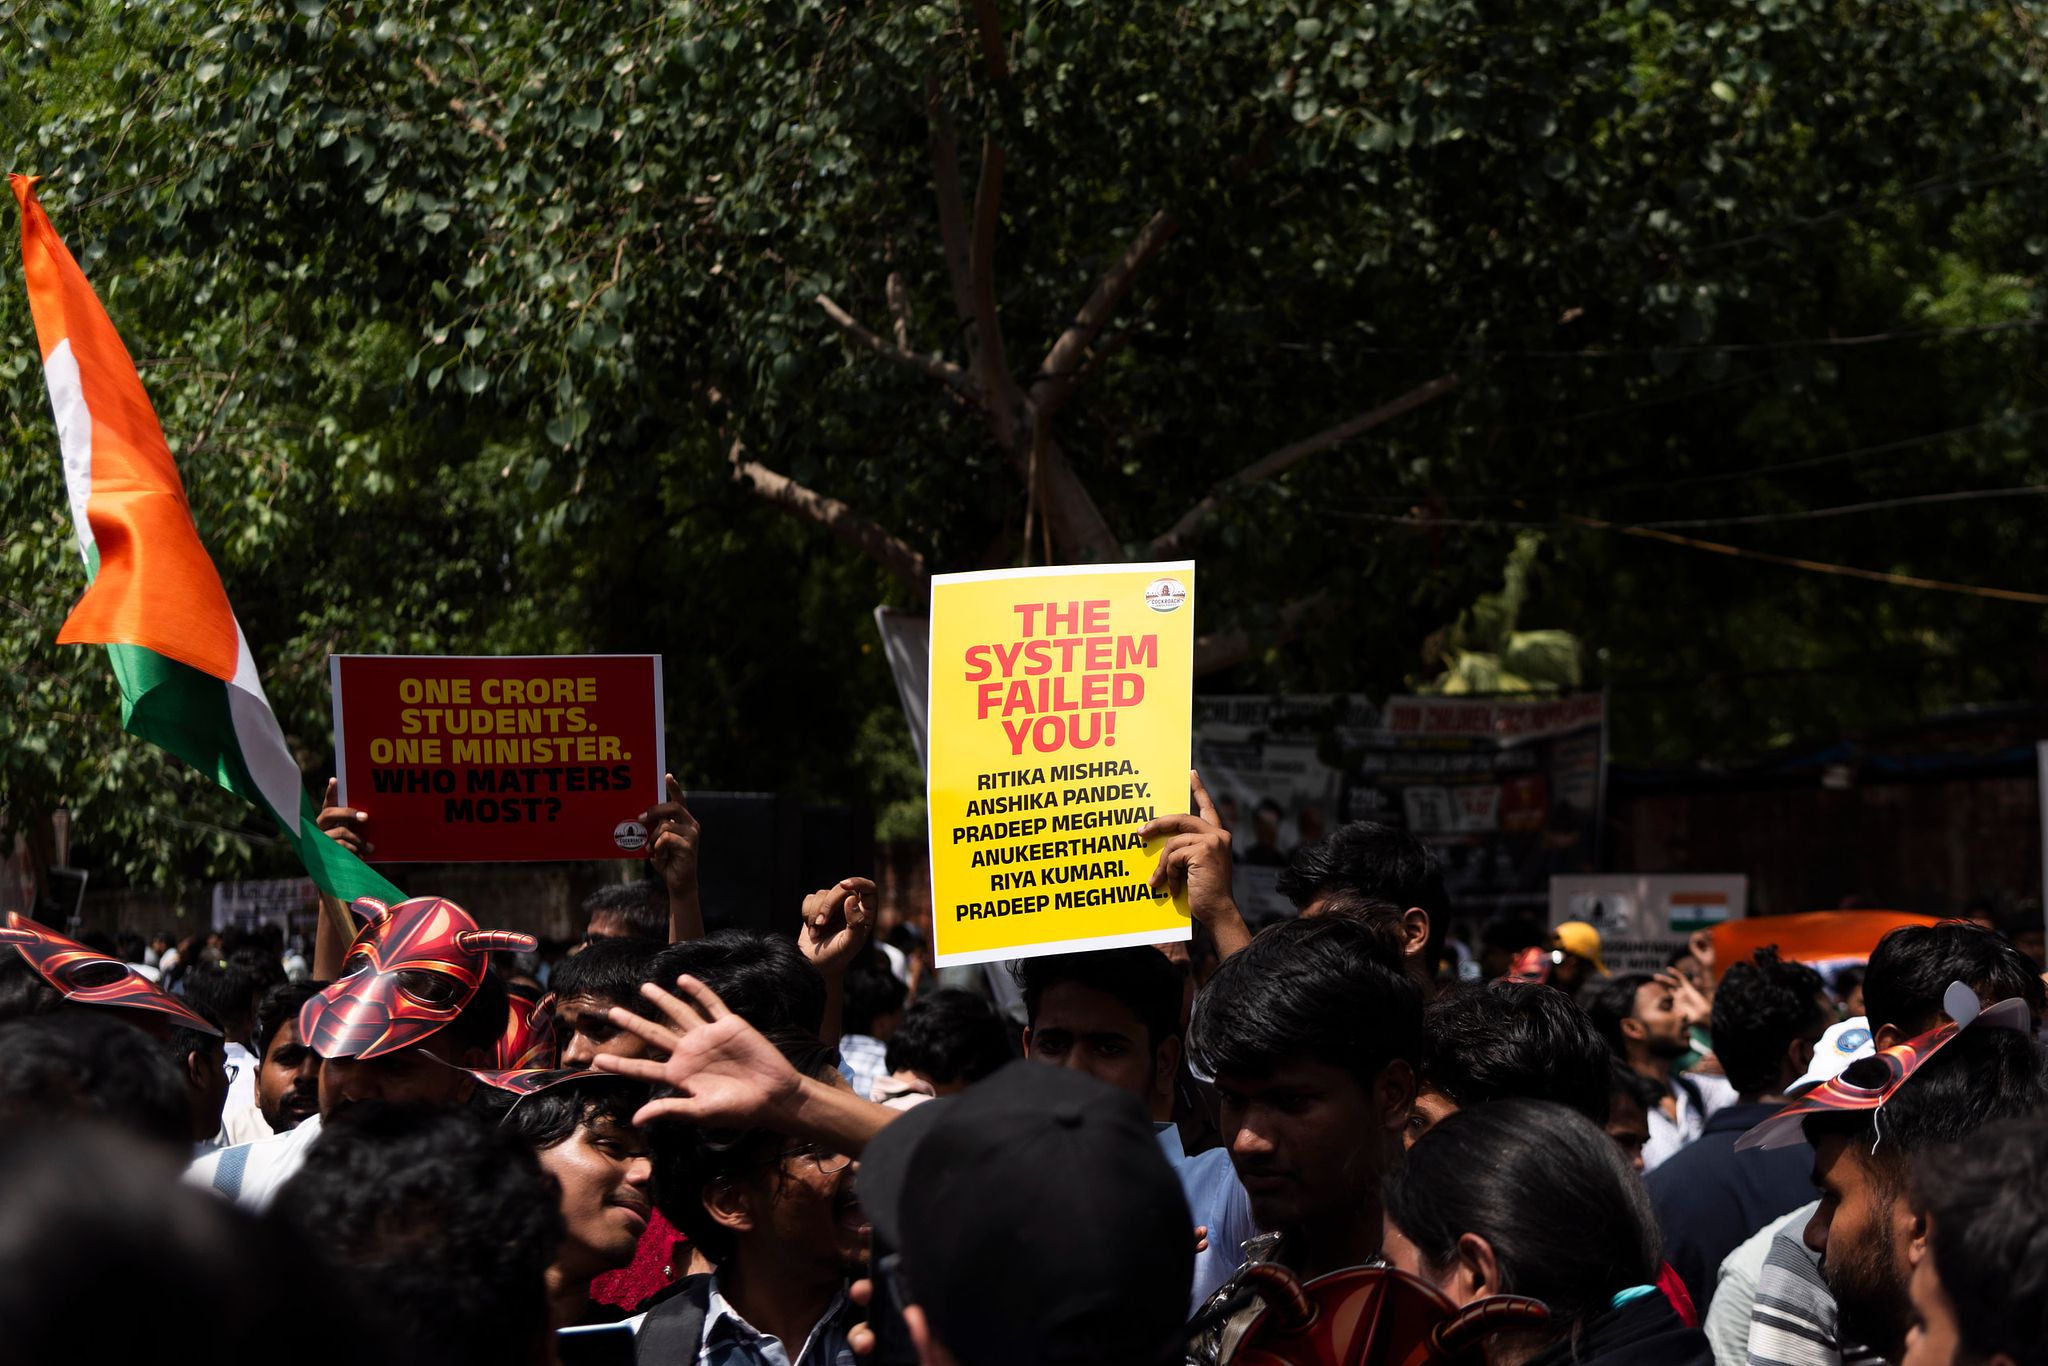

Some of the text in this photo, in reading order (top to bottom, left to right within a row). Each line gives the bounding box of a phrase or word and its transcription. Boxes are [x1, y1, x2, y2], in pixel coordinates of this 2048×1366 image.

[1013, 600, 1110, 638] THE
[964, 634, 1158, 682] SYSTEM
[399, 677, 597, 705] ONE CRORE
[977, 672, 1145, 720] FAILED
[401, 707, 597, 734] STUDENTS.
[1001, 711, 1117, 756] YOU!
[370, 736, 632, 764] ONE MINISTER.
[372, 765, 631, 794] WHO MATTERS
[977, 760, 1140, 791] RITIKA MISHRA.
[445, 797, 562, 824] MOST?
[966, 782, 1152, 818] ANSHIKA PANDEY.
[952, 819, 1047, 845] PRADEEP
[971, 832, 1148, 869] ANUKEERTHANA.
[990, 860, 1130, 892] RIYA KUMARI.
[956, 894, 1050, 922] PRADEEP
